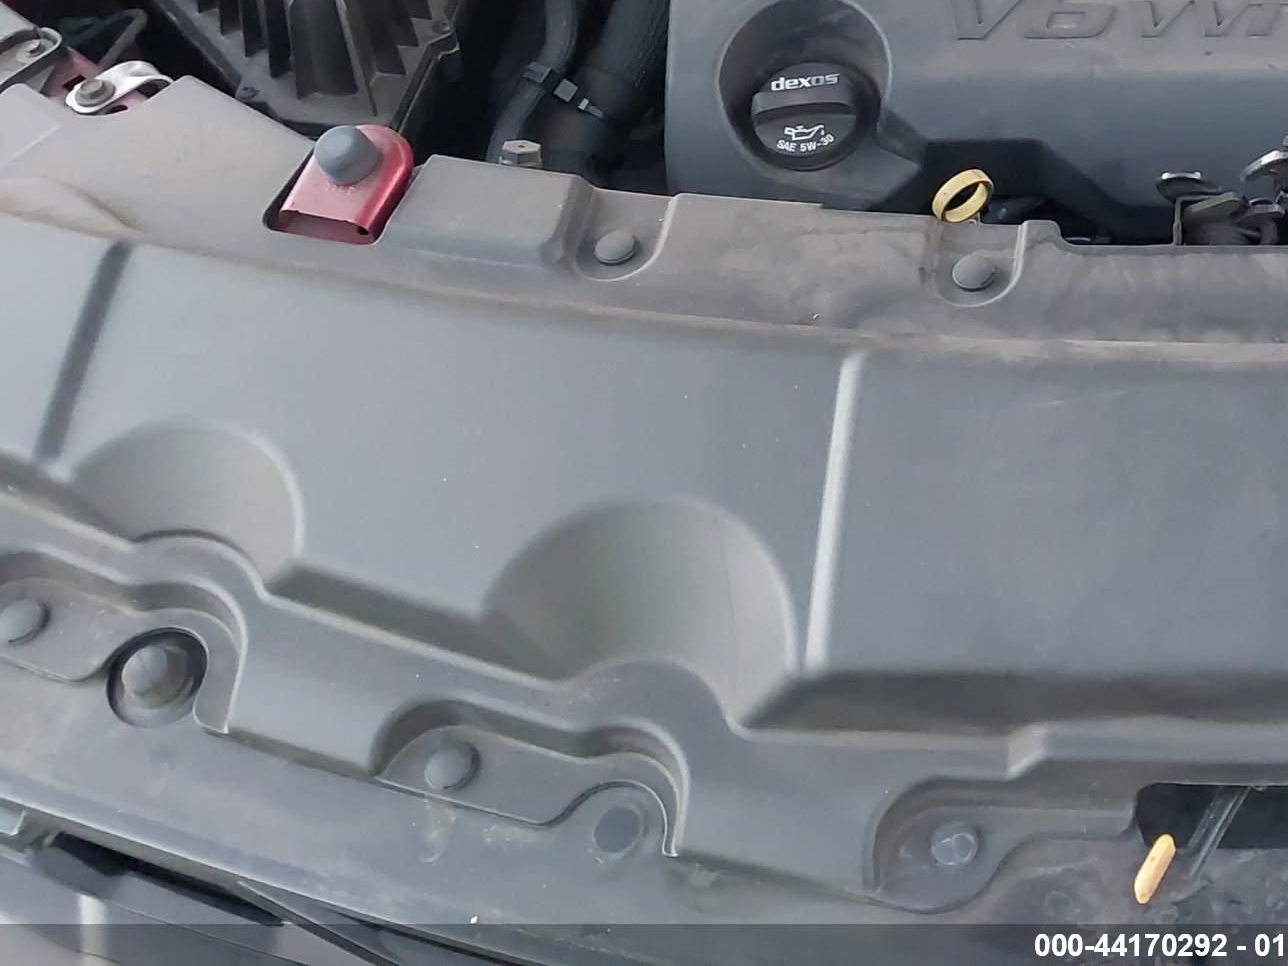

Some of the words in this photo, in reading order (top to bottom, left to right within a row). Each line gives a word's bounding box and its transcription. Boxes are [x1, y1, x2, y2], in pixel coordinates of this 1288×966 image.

[771, 73, 840, 91] dexos
[776, 139, 797, 152] SAE
[800, 134, 834, 152] 5W-30
